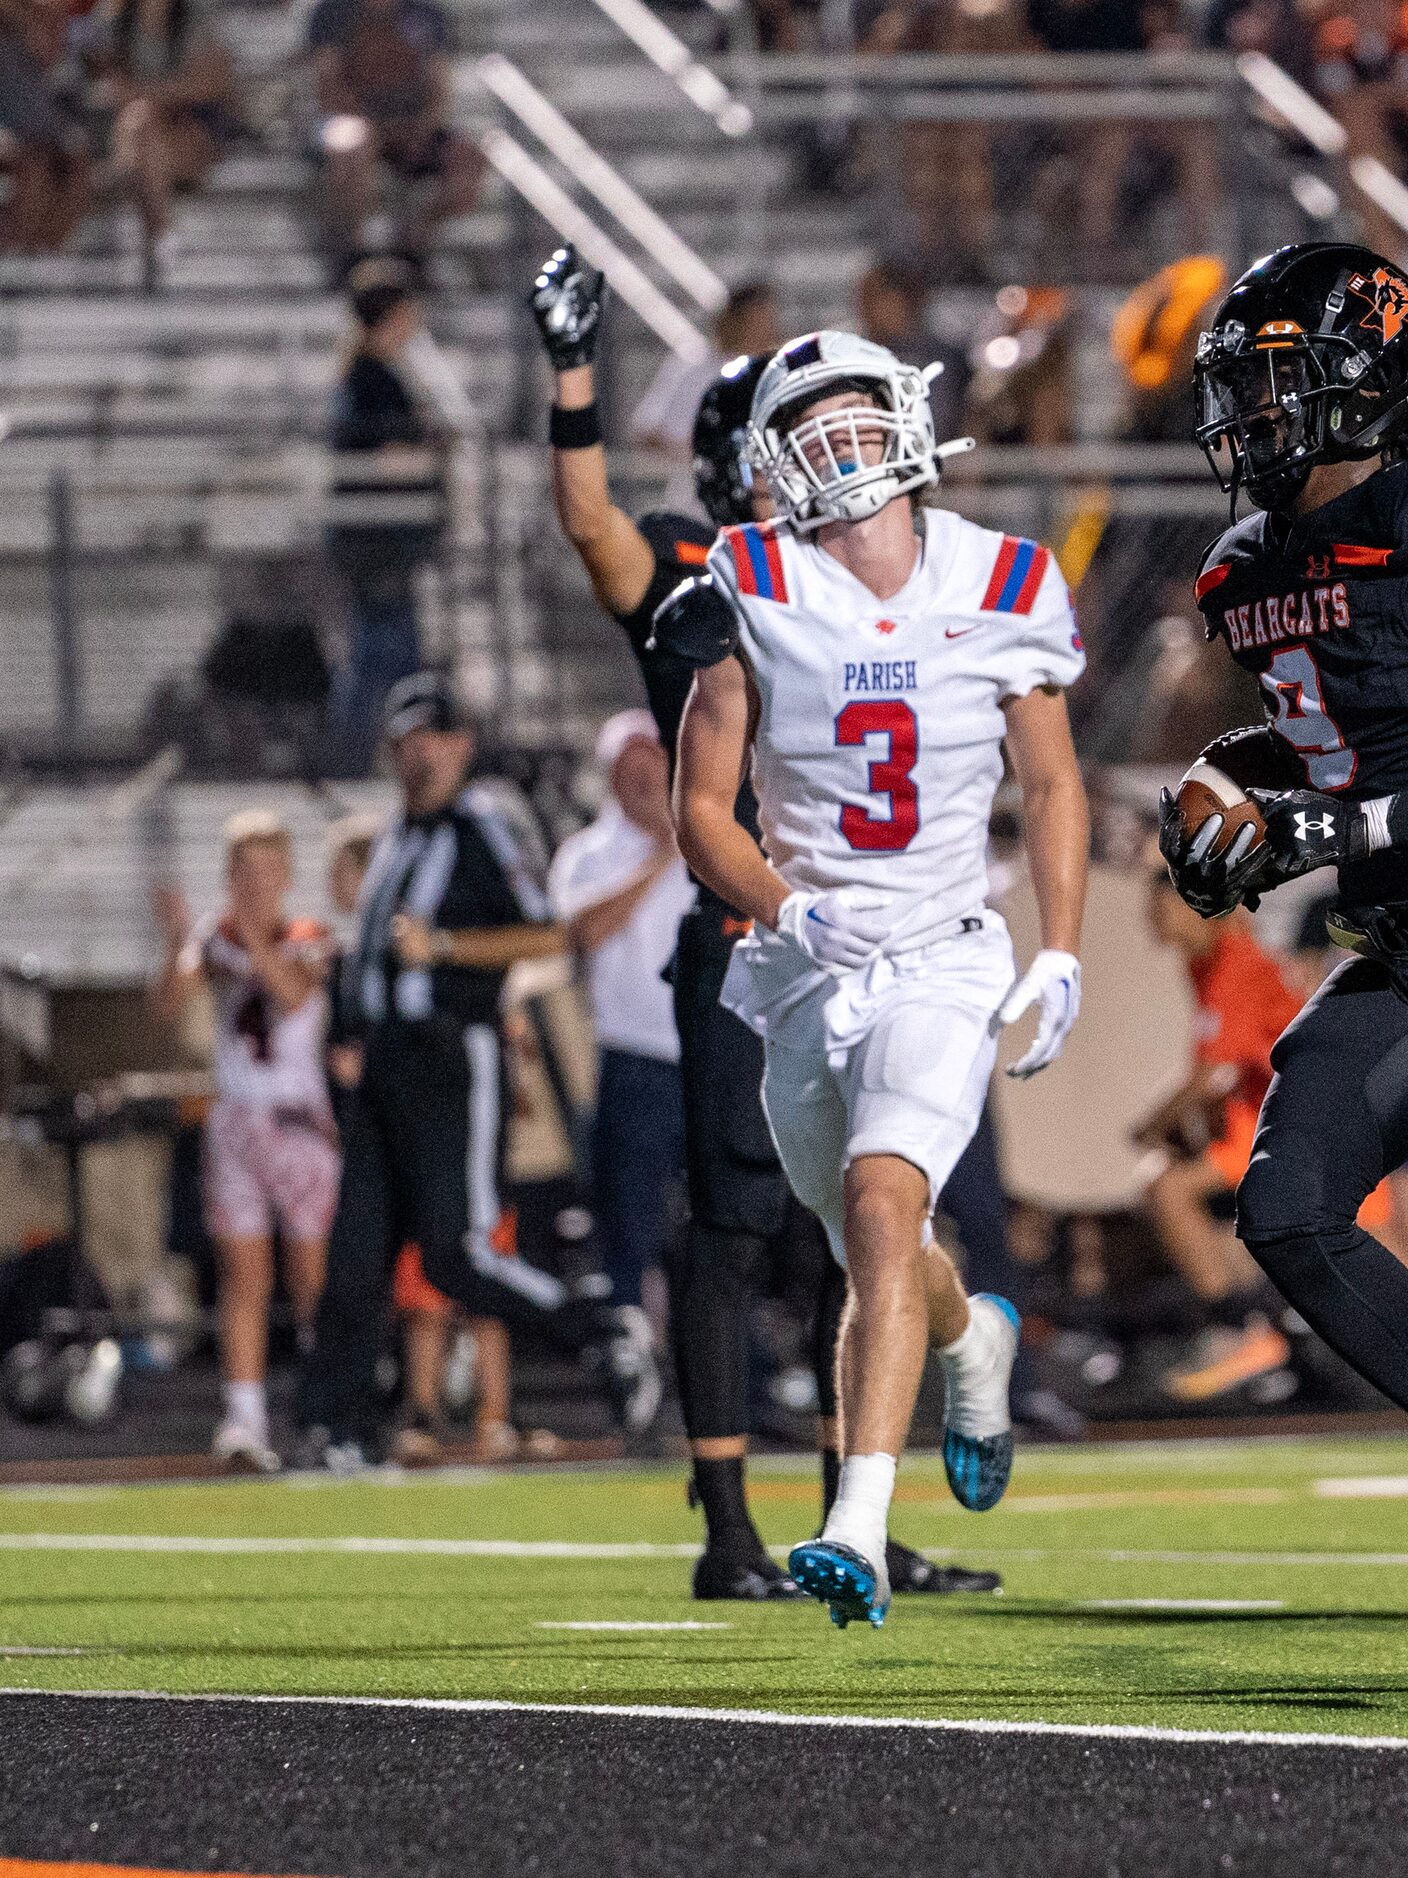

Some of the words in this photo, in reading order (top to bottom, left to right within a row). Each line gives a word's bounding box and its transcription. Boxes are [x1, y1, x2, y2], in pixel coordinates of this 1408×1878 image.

[1224, 582, 1351, 652] BEARCATS
[844, 660, 918, 692] PARISH
[1259, 642, 1359, 794] 9
[834, 698, 920, 851] 3
